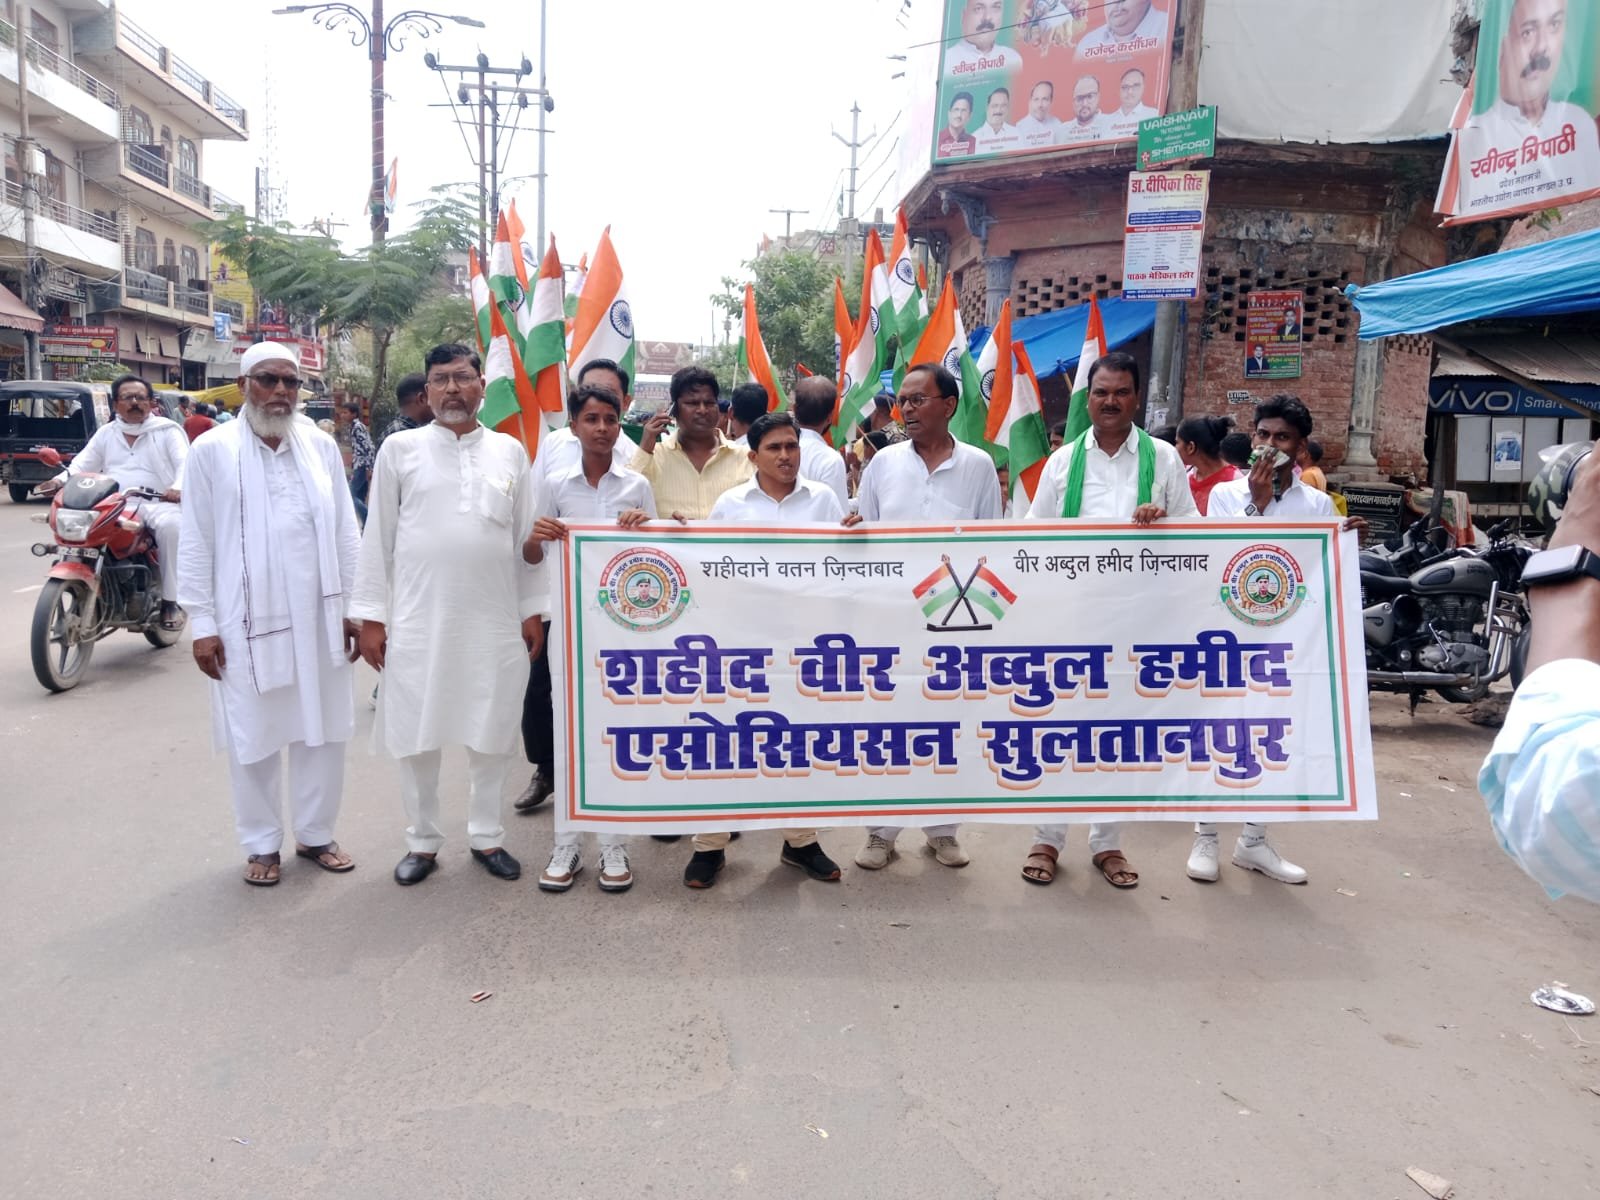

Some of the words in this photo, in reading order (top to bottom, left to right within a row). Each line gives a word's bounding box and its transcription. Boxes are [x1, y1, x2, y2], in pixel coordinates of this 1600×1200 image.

[1143, 109, 1209, 131] VAISHNAVI
[1151, 139, 1210, 157] SHEMFORD
[1470, 148, 1519, 178] रवीन्द्र
[1521, 123, 1576, 165] त्रिपाठी
[1146, 175, 1181, 192] दीपिका
[1183, 173, 1203, 191] सिंह
[700, 556, 769, 579] शहीदाने
[776, 561, 816, 578] वतन
[822, 556, 904, 581] ज़िन्दाबाद
[1013, 549, 1039, 573] वीर
[1045, 555, 1090, 580] अब्दुल
[1096, 548, 1134, 574] हमीद
[1140, 548, 1209, 576] ज़िन्दाबाद
[597, 634, 774, 704] शहीद
[789, 633, 900, 700] वीर
[923, 644, 1112, 716] अब्दुल
[1128, 630, 1293, 697] हमीद
[602, 711, 960, 780] एसोसियसन
[977, 718, 1292, 790] सुलतानपुर
